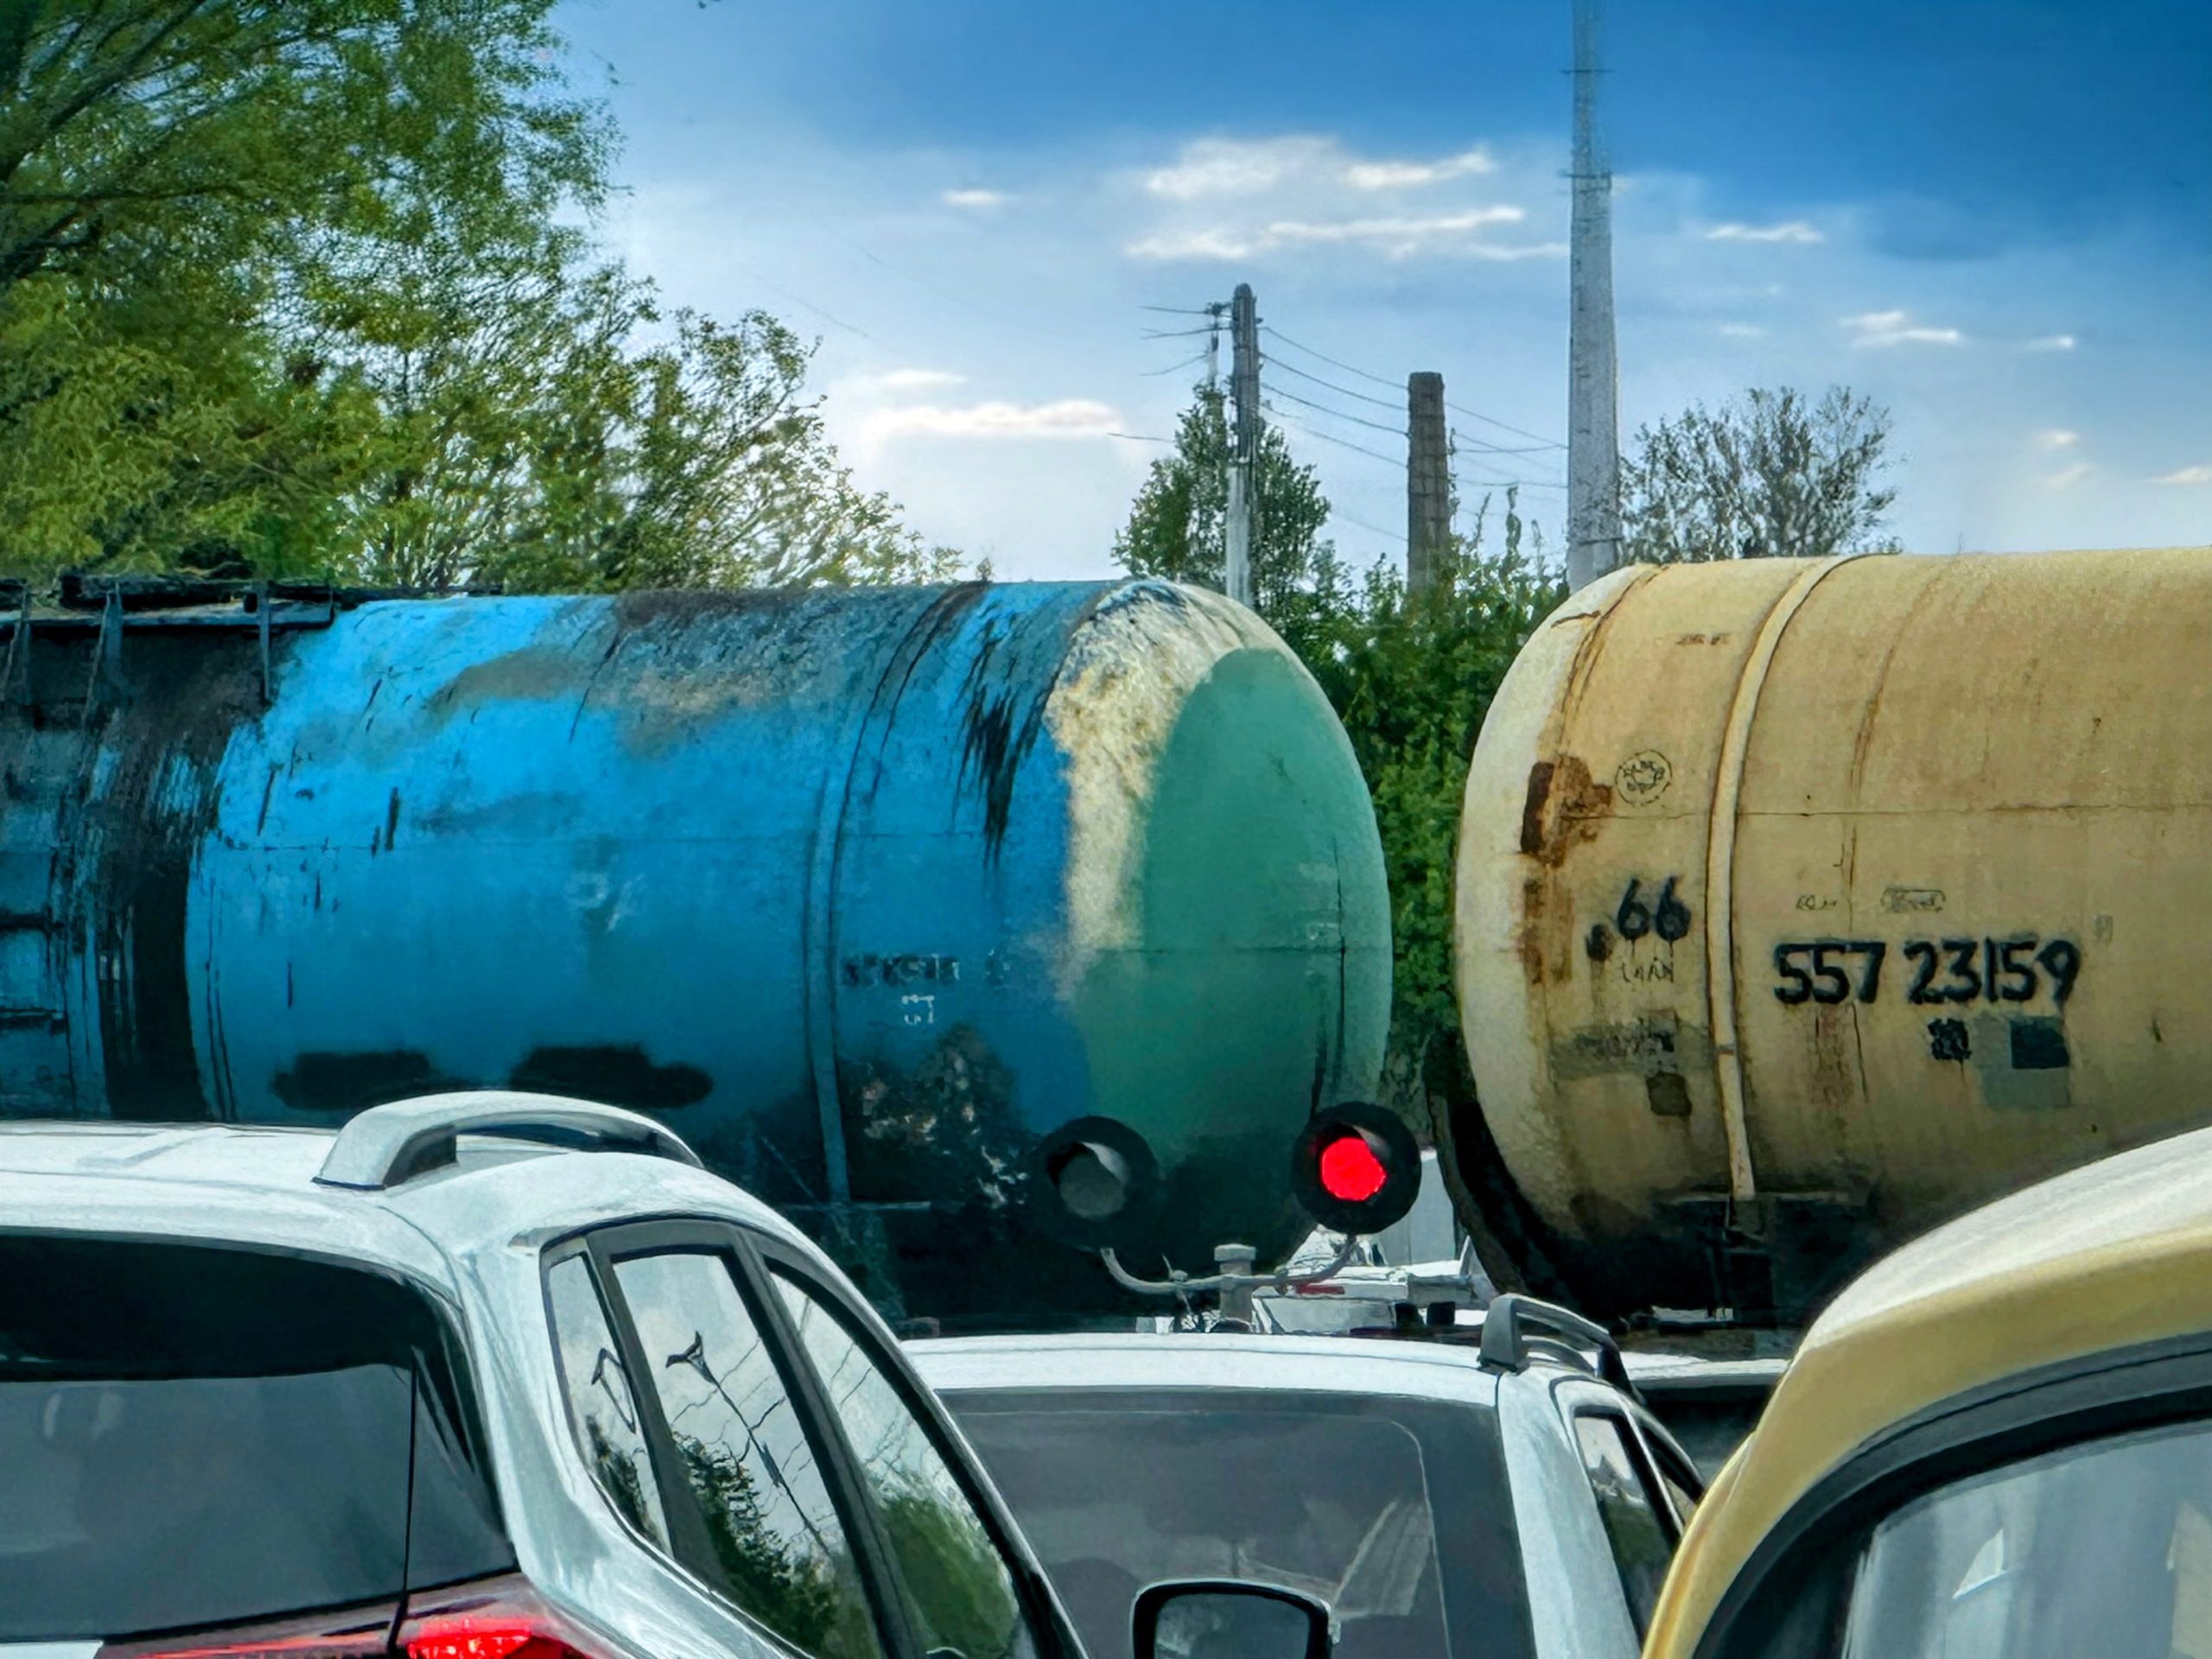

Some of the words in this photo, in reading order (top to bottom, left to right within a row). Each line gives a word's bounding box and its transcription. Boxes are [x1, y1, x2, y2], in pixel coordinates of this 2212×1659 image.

[1617, 876, 1692, 942] 66
[1774, 941, 1886, 1004] 557
[1904, 938, 2081, 1007] 23159
